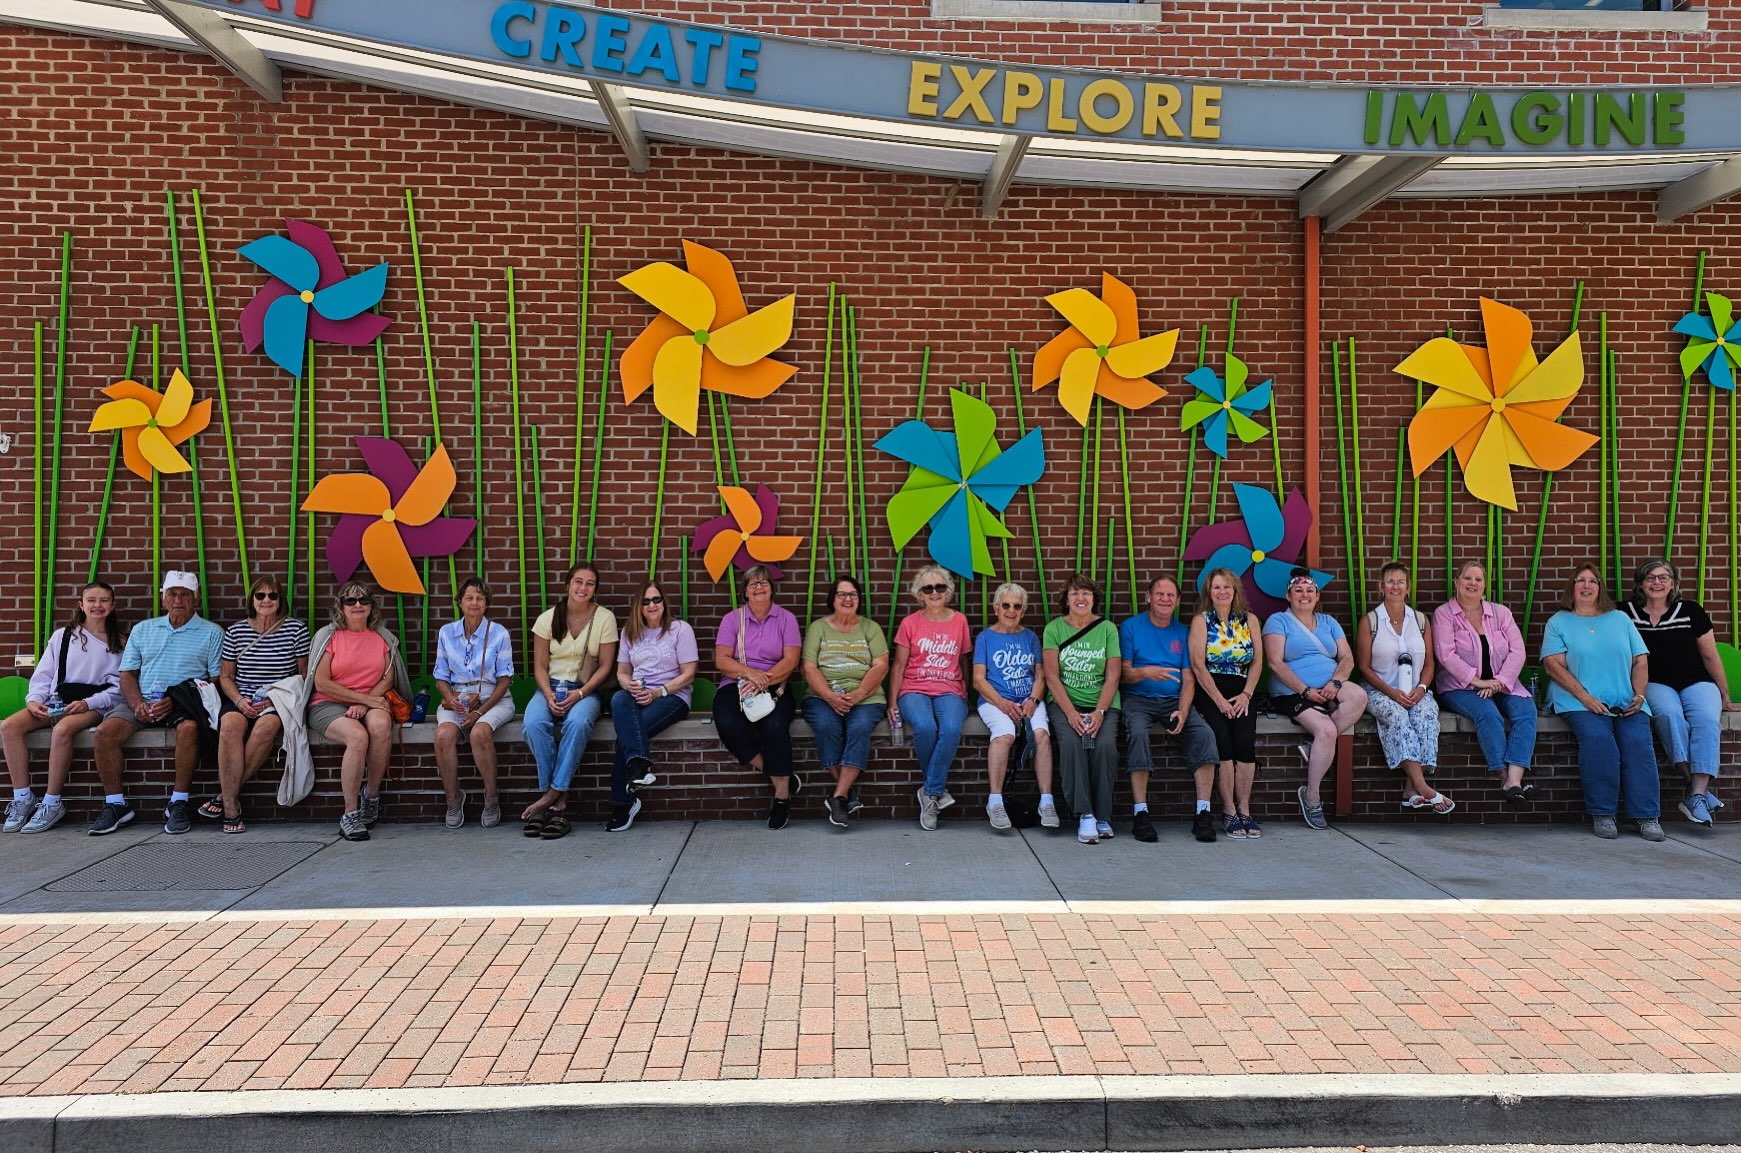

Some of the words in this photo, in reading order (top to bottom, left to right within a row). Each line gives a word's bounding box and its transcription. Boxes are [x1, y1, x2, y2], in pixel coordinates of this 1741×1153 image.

[490, 2, 762, 93] CREATE
[907, 61, 1223, 140] EXPLORE
[1363, 90, 1686, 146] IMAGINE
[992, 649, 1036, 669] Oldest
[1059, 645, 1106, 662] Youngest
[1064, 656, 1096, 672] Sister
